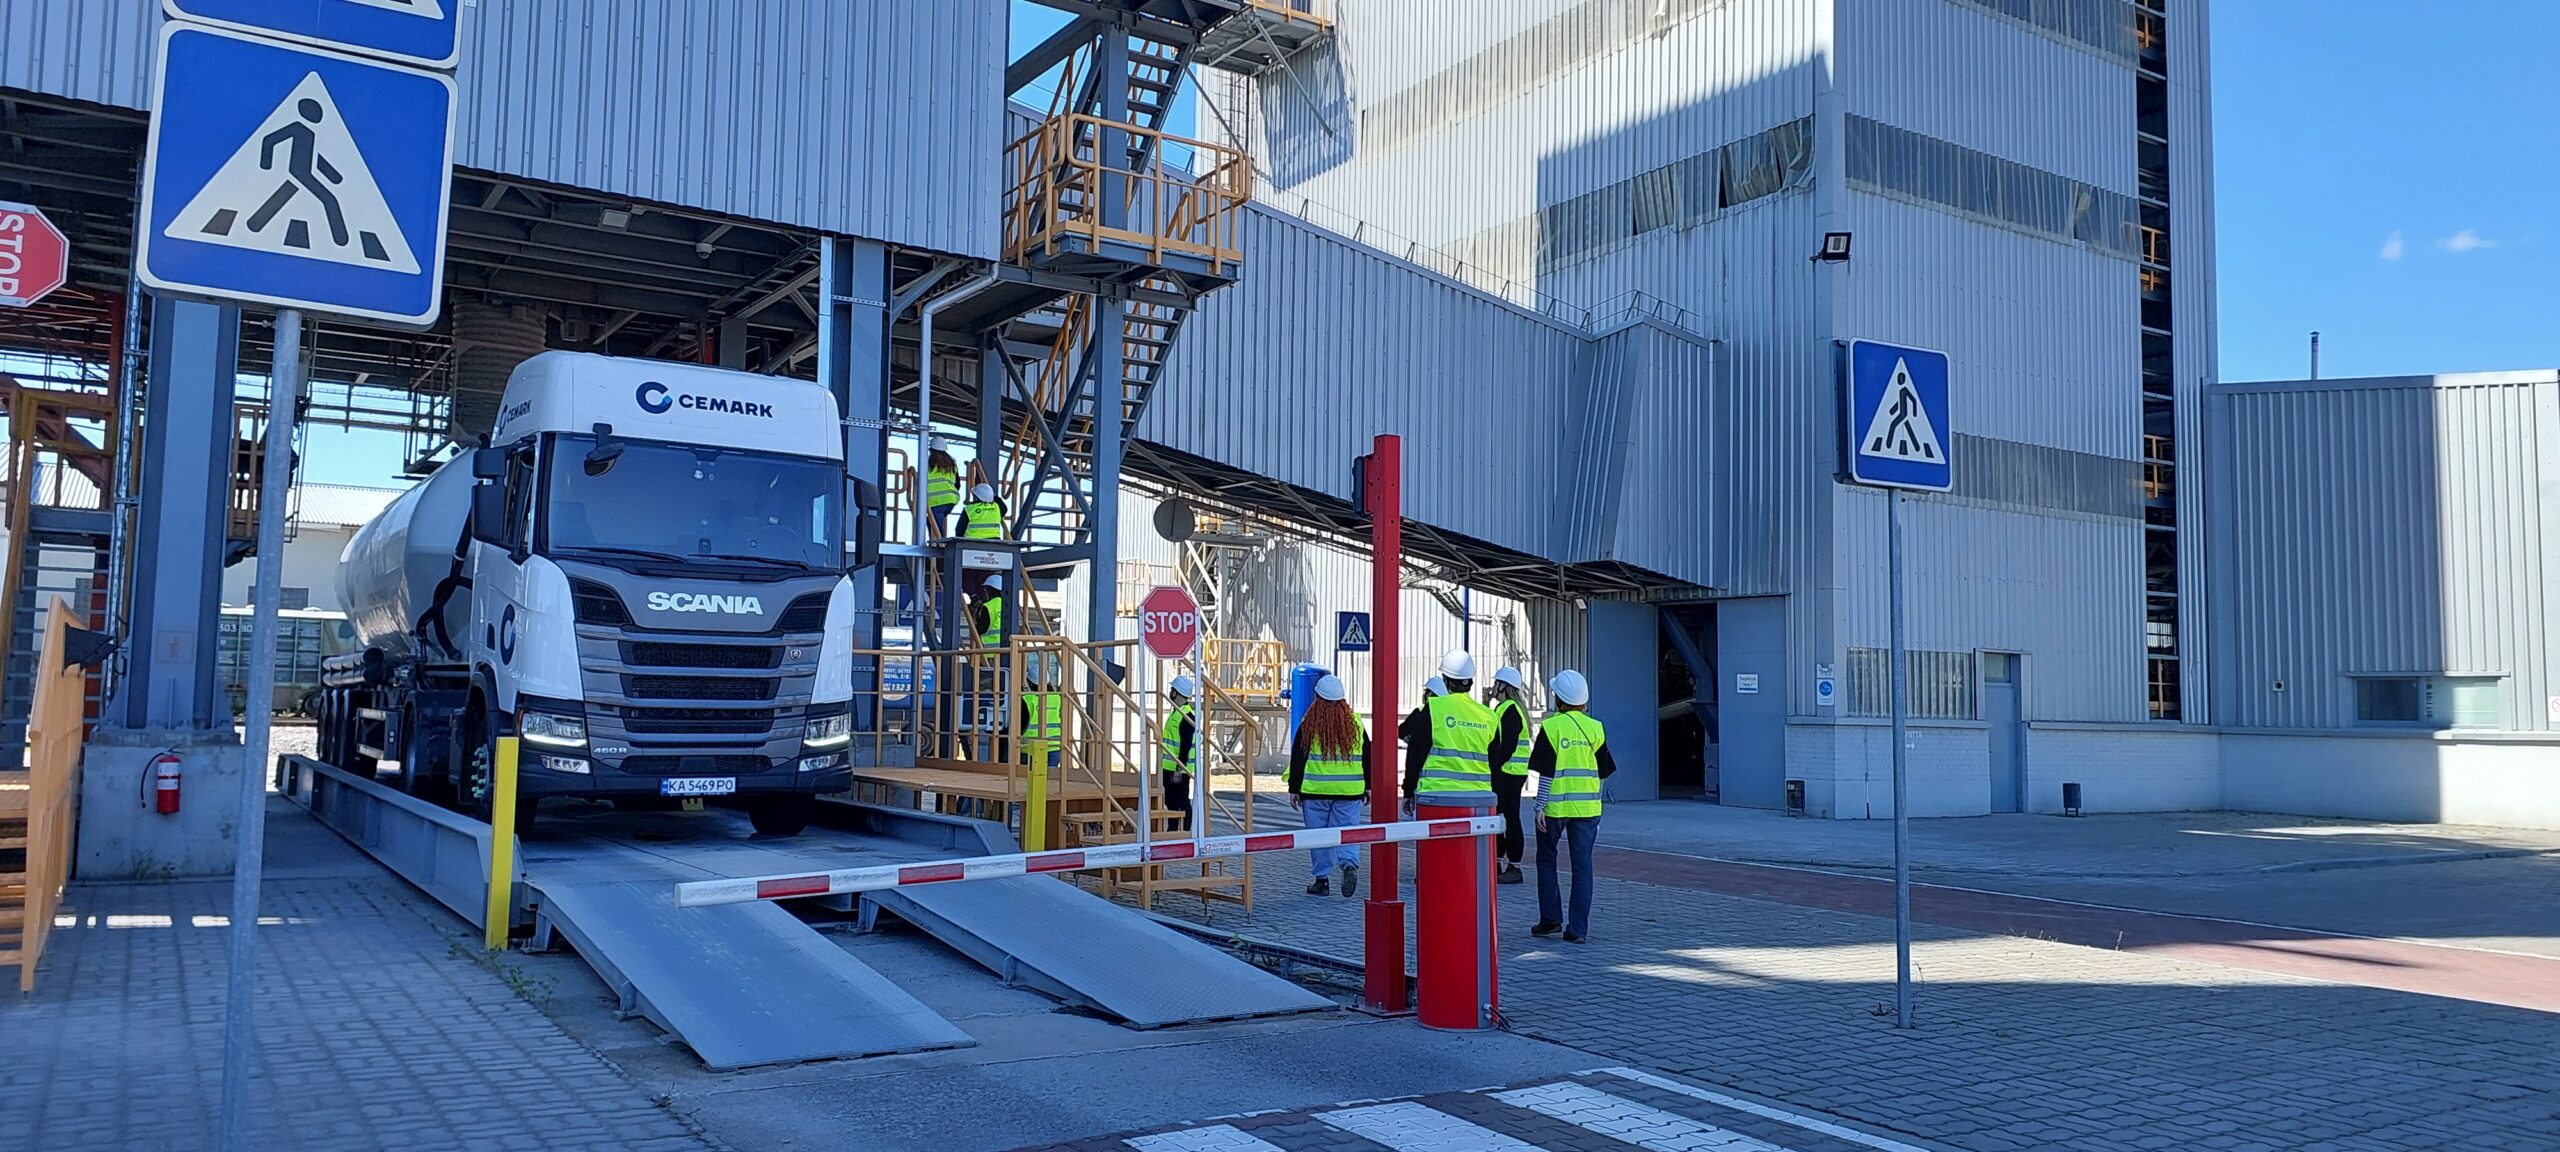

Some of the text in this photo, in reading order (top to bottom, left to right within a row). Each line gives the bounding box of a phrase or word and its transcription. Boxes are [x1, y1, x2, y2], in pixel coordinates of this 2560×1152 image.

[507, 399, 532, 423] CEMARK
[679, 394, 773, 418] CEMARK
[647, 591, 763, 615] SCANIA
[1145, 611, 1195, 634] STOP
[1457, 720, 1488, 730] CEMARK
[668, 779, 734, 792] KA 5469 PO
